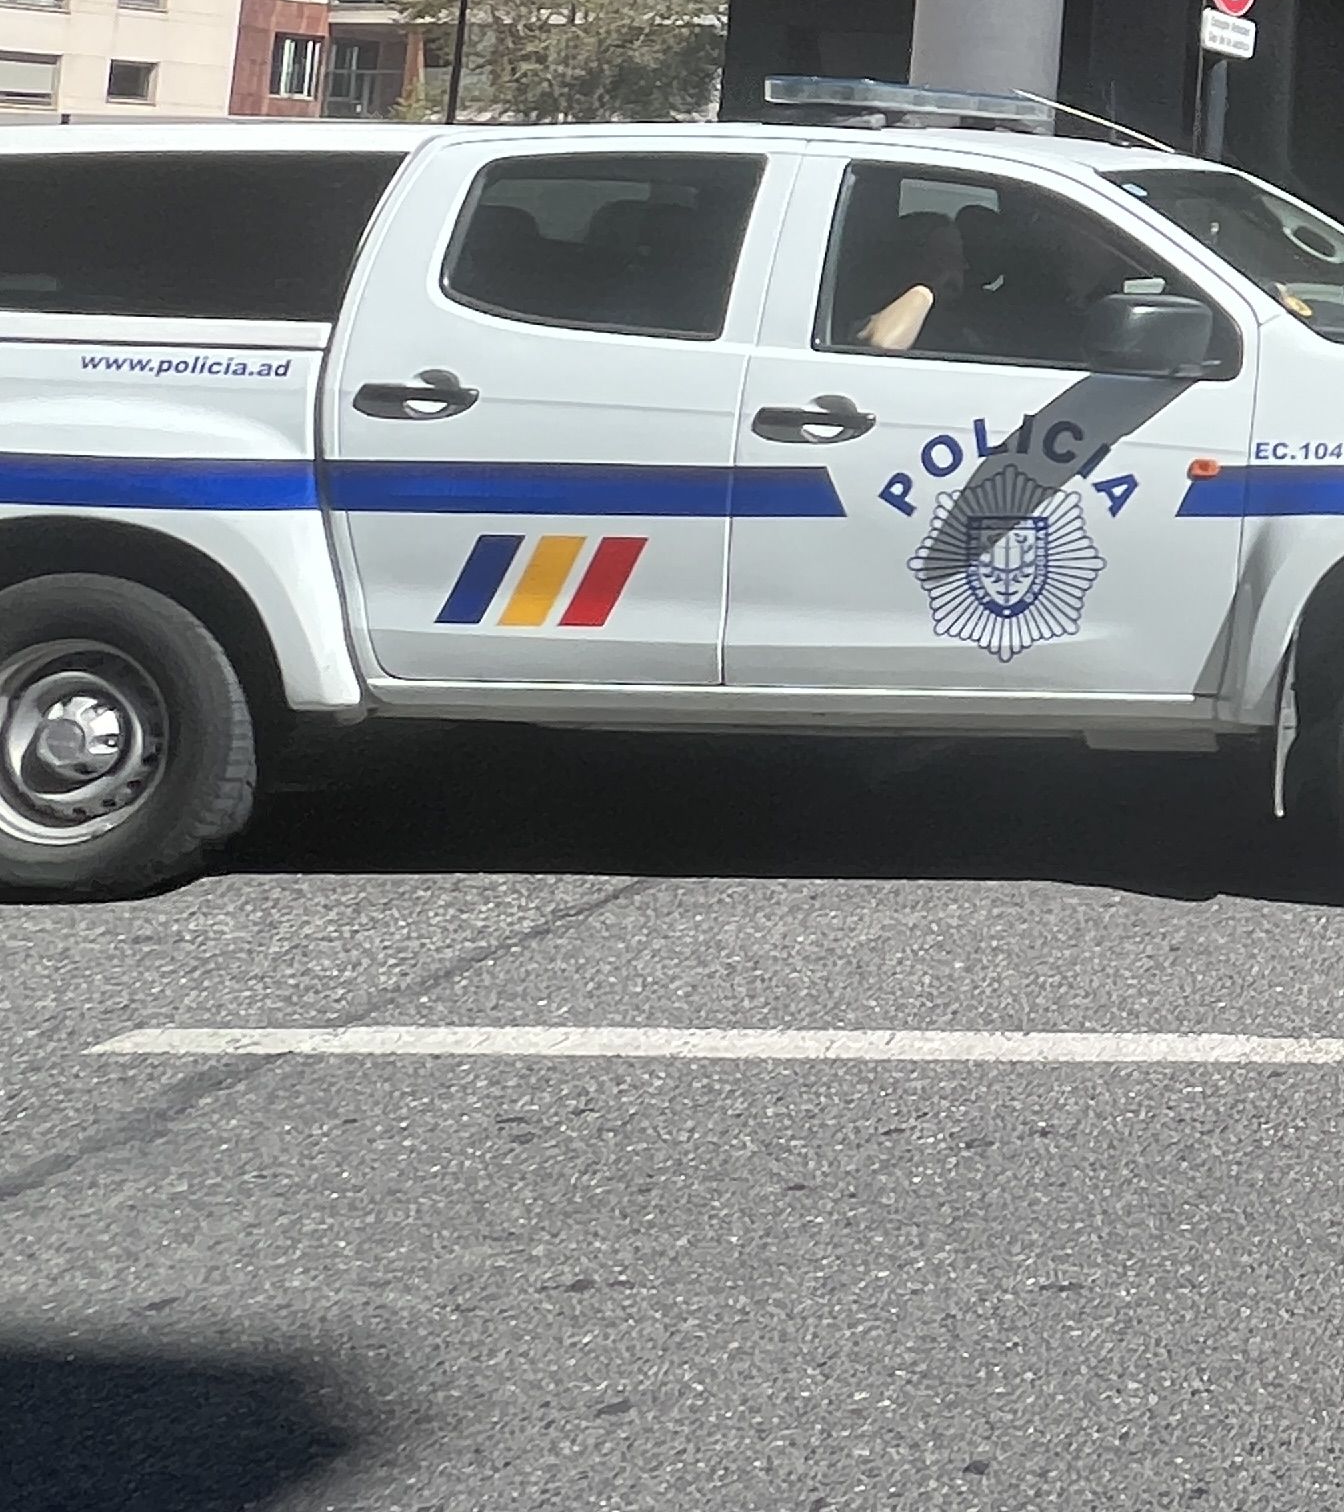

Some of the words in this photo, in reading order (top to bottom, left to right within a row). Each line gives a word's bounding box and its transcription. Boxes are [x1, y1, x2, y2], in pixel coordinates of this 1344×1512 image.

[80, 354, 292, 378] www.policia.ad
[1254, 441, 1344, 461] EC.104
[878, 413, 1140, 518] POLICIA
